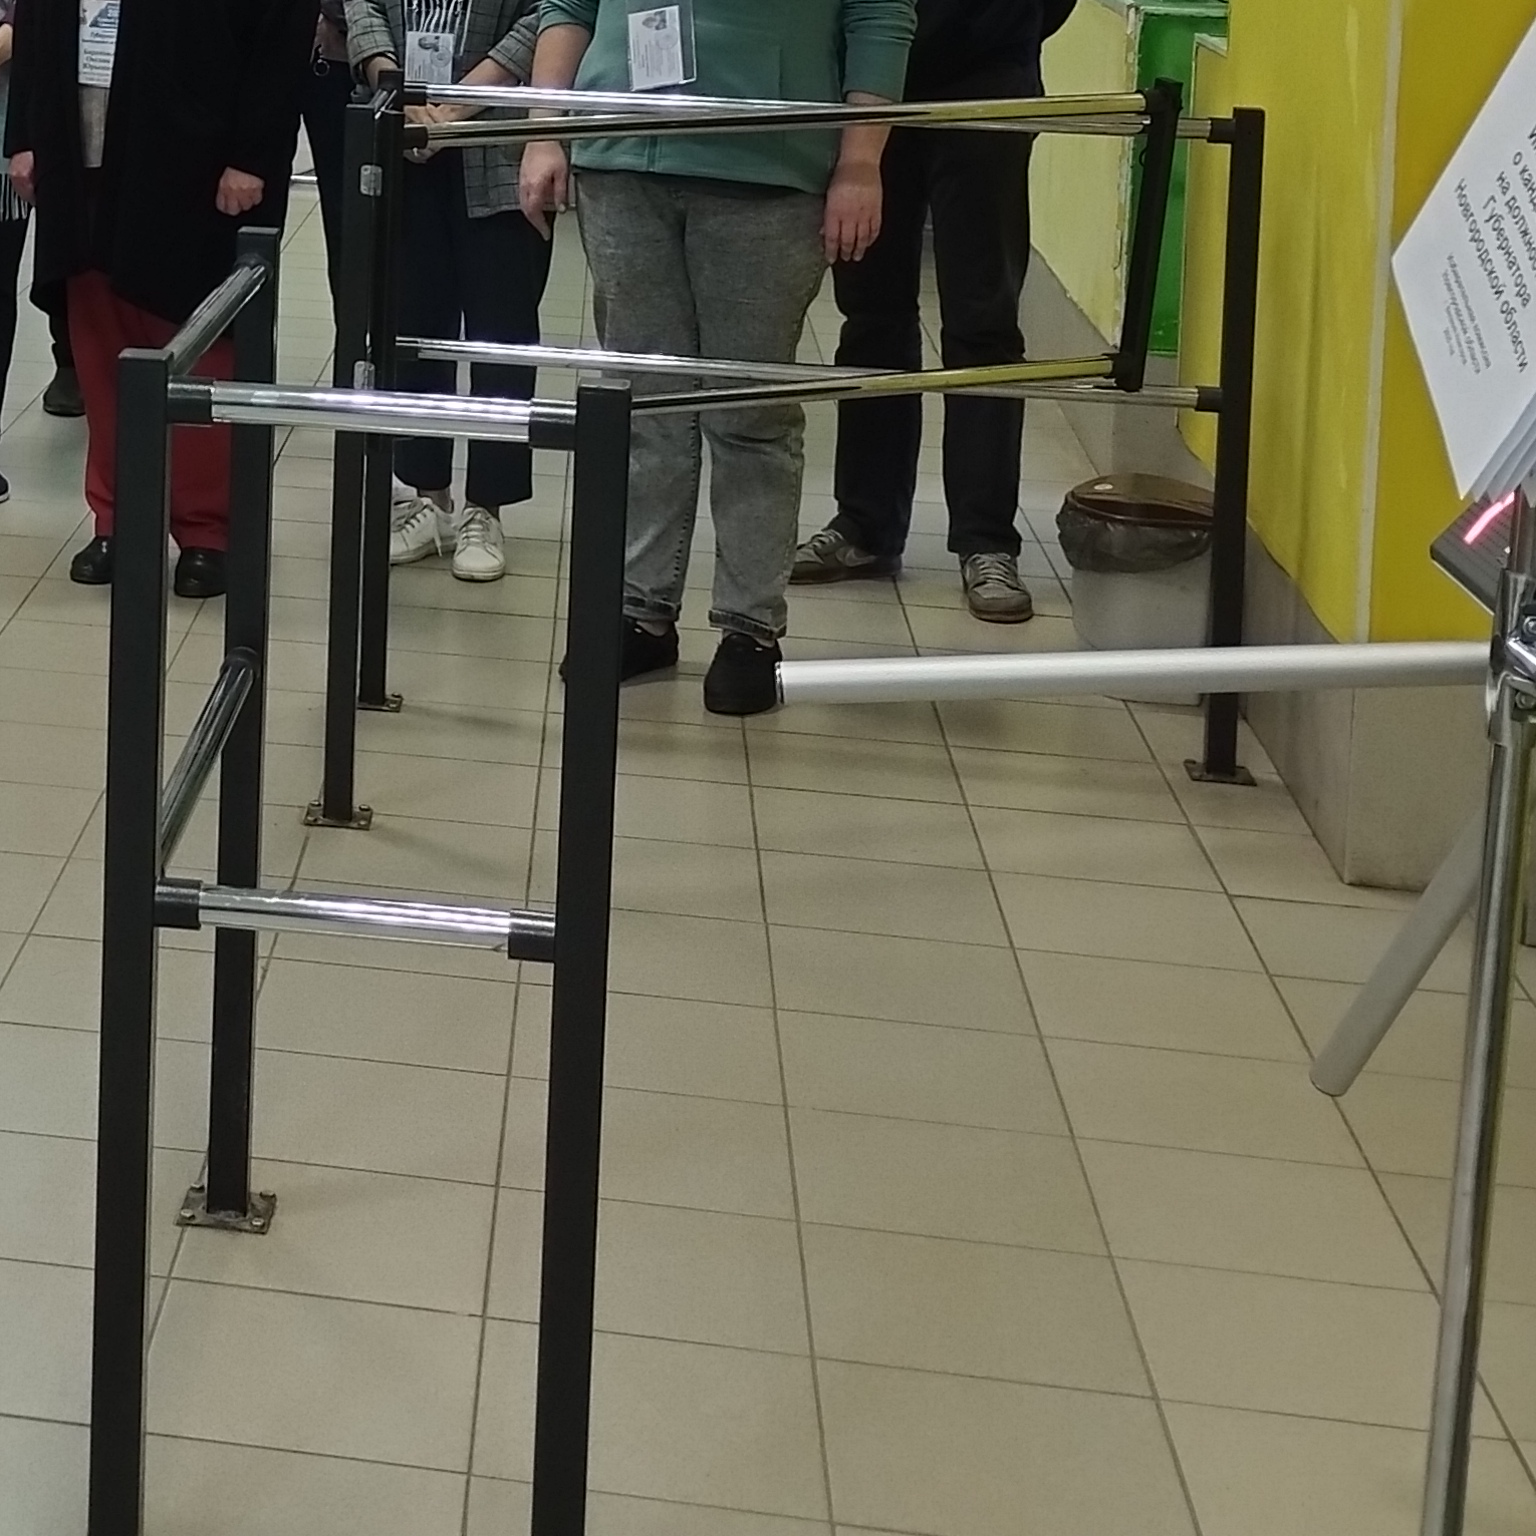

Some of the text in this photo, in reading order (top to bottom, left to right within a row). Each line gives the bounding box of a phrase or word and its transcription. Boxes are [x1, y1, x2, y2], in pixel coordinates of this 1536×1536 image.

[1496, 170, 1511, 196] на
[1454, 177, 1506, 301] Новгородской
[1500, 300, 1528, 373] области
[1482, 195, 1531, 308] Губернатора
